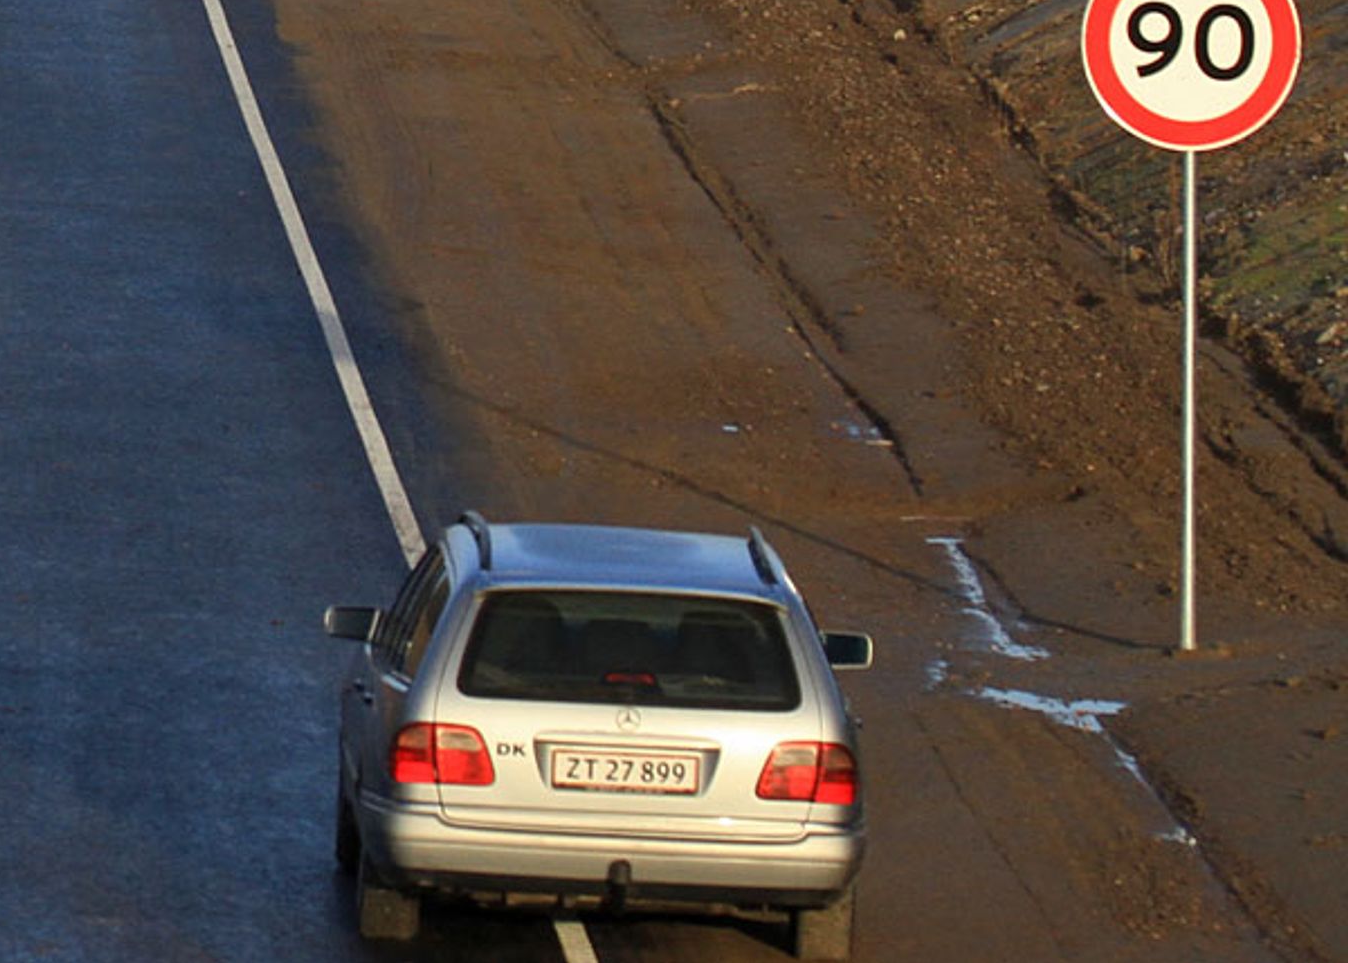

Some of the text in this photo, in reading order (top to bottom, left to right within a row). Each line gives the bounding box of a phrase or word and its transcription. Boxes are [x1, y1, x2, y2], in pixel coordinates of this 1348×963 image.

[1126, 1, 1256, 82] 90
[496, 743, 526, 757] DK
[565, 757, 686, 785] ZT 27 899
